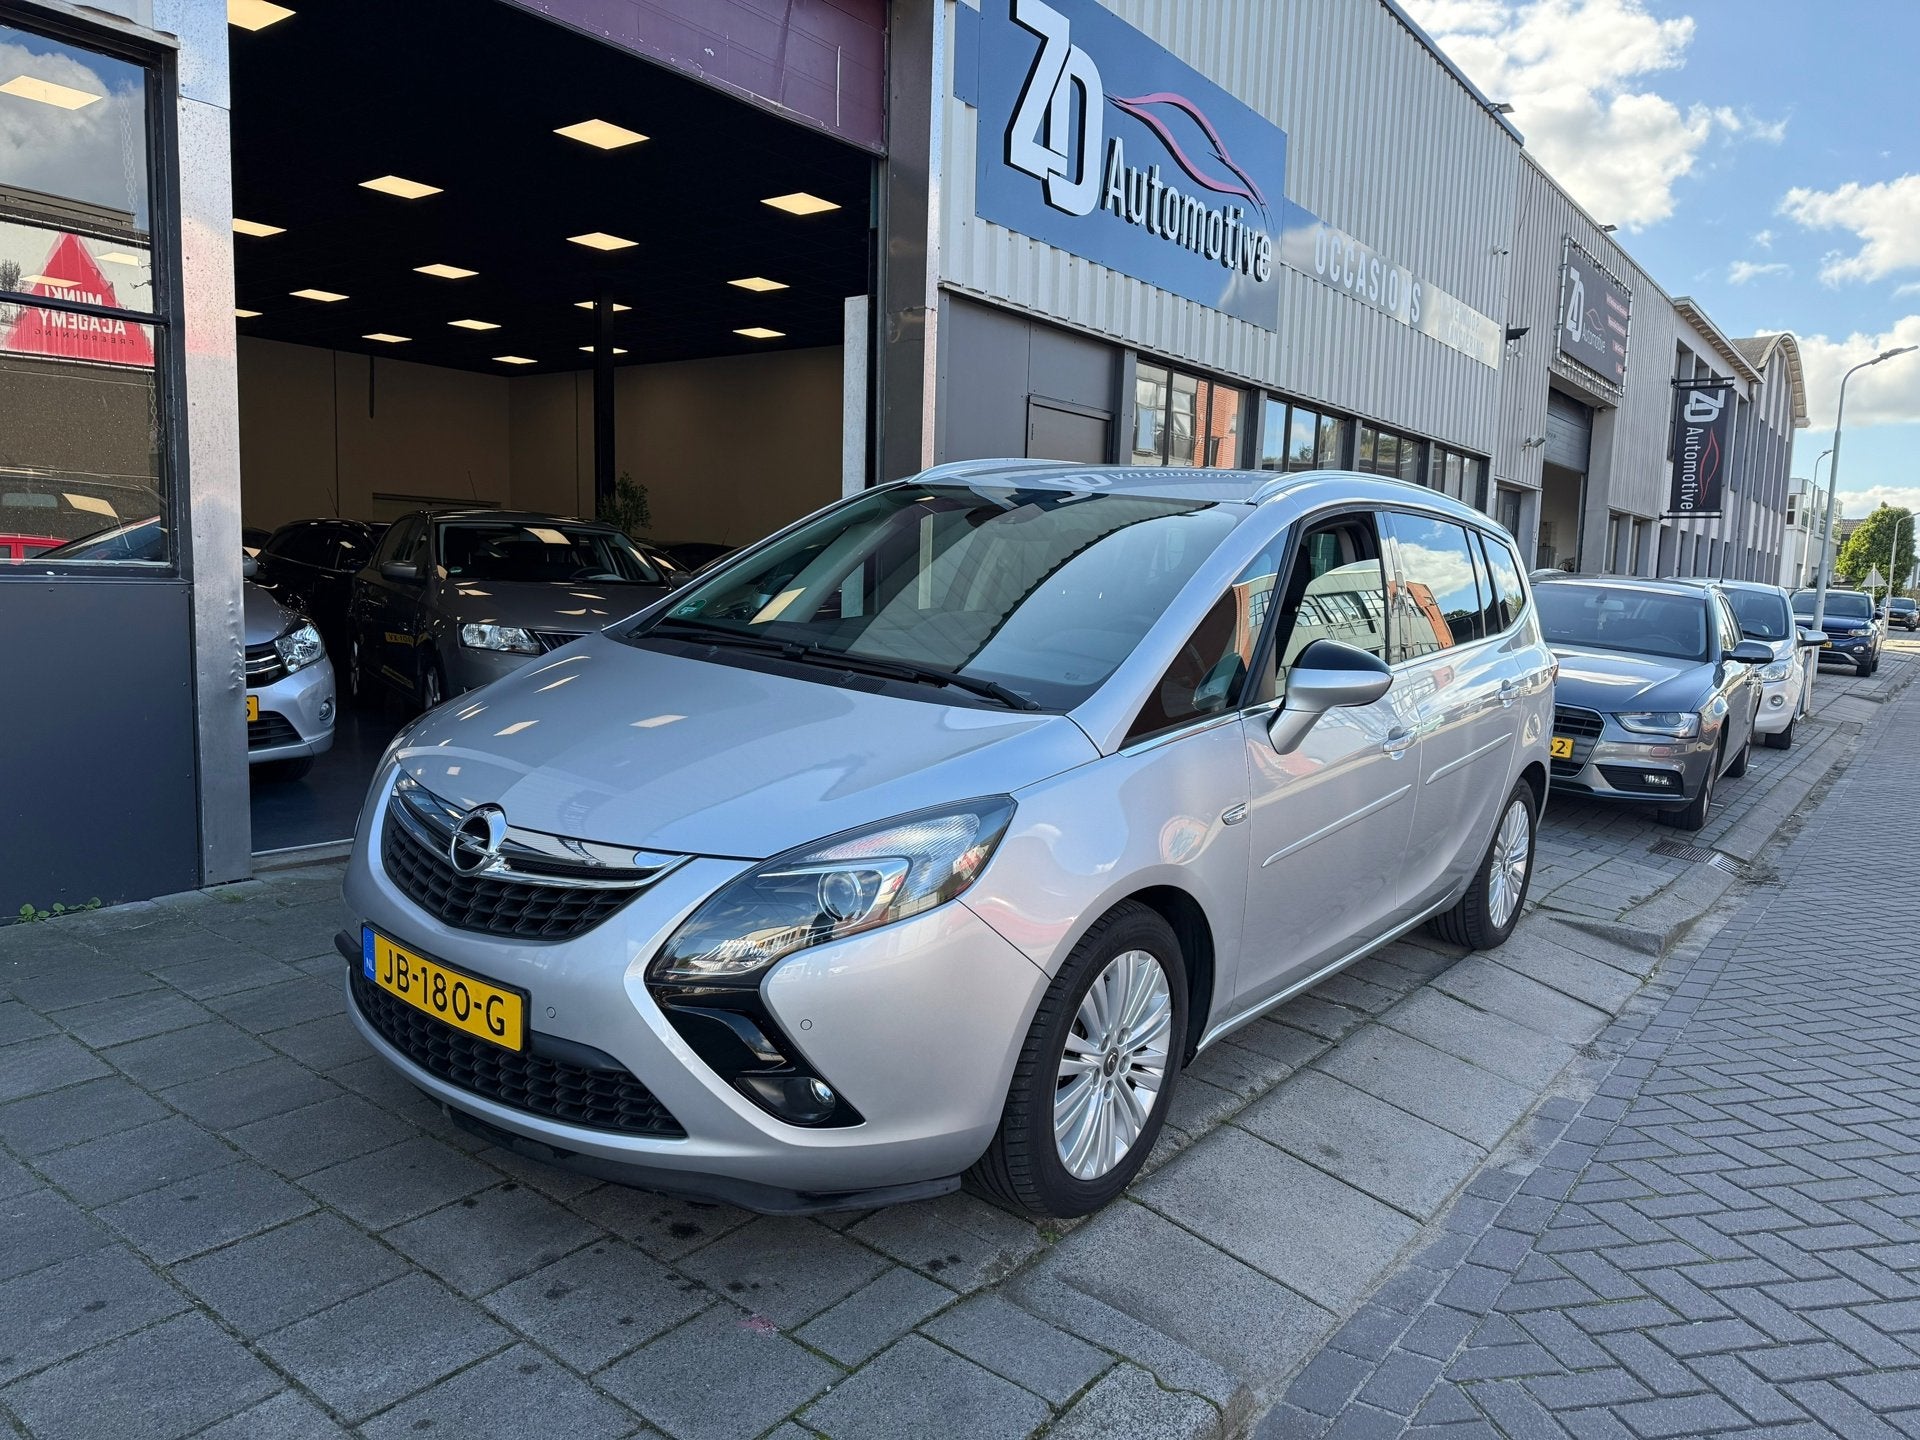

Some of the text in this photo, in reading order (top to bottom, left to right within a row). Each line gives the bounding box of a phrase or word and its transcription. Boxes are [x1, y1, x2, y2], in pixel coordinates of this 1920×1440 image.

[1103, 136, 1272, 282] Automotive
[1314, 230, 1421, 323] OCCASIONS
[1680, 426, 1704, 510] Automotive
[383, 949, 505, 1037] JB-180-G
